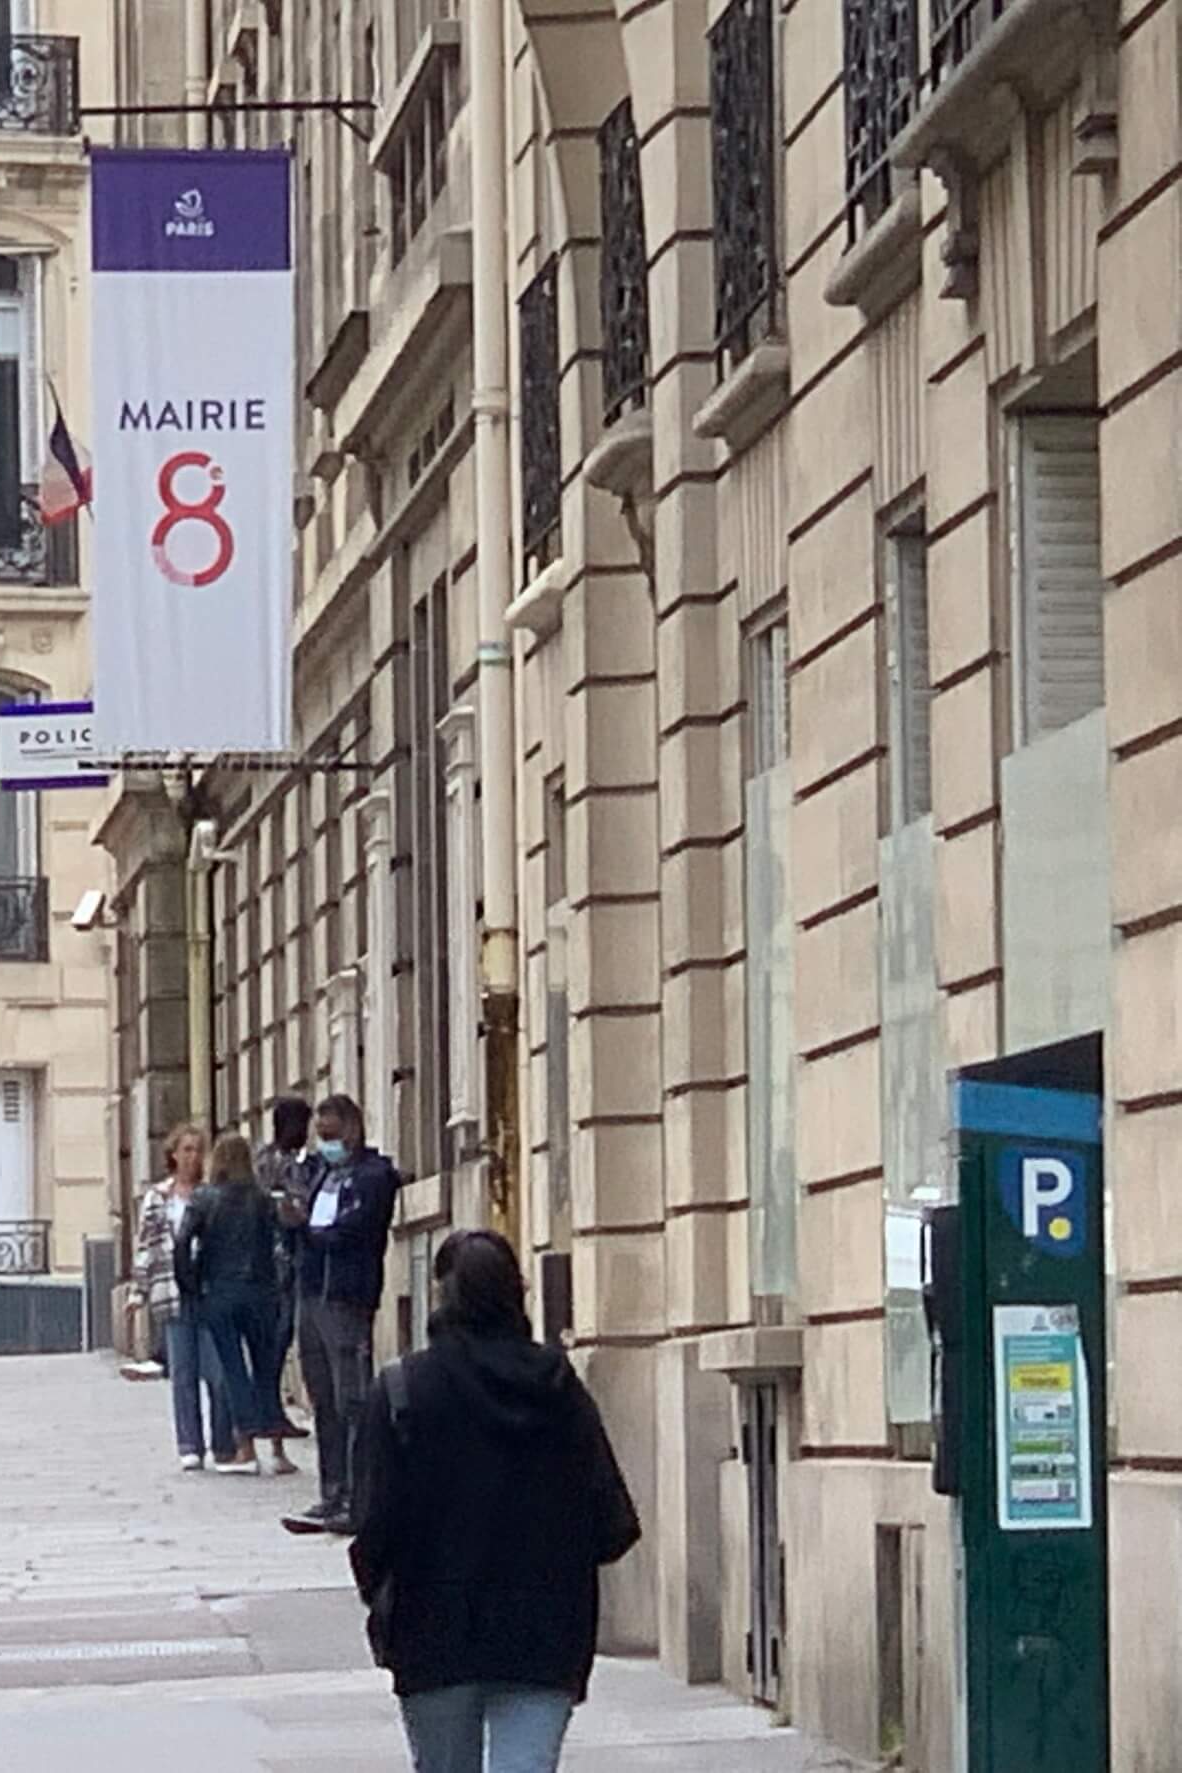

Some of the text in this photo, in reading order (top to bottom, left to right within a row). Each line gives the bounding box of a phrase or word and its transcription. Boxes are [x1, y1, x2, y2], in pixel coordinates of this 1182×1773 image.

[165, 220, 215, 237] PARIS
[119, 398, 267, 432] MAIRIE
[19, 728, 91, 744] POLIC
